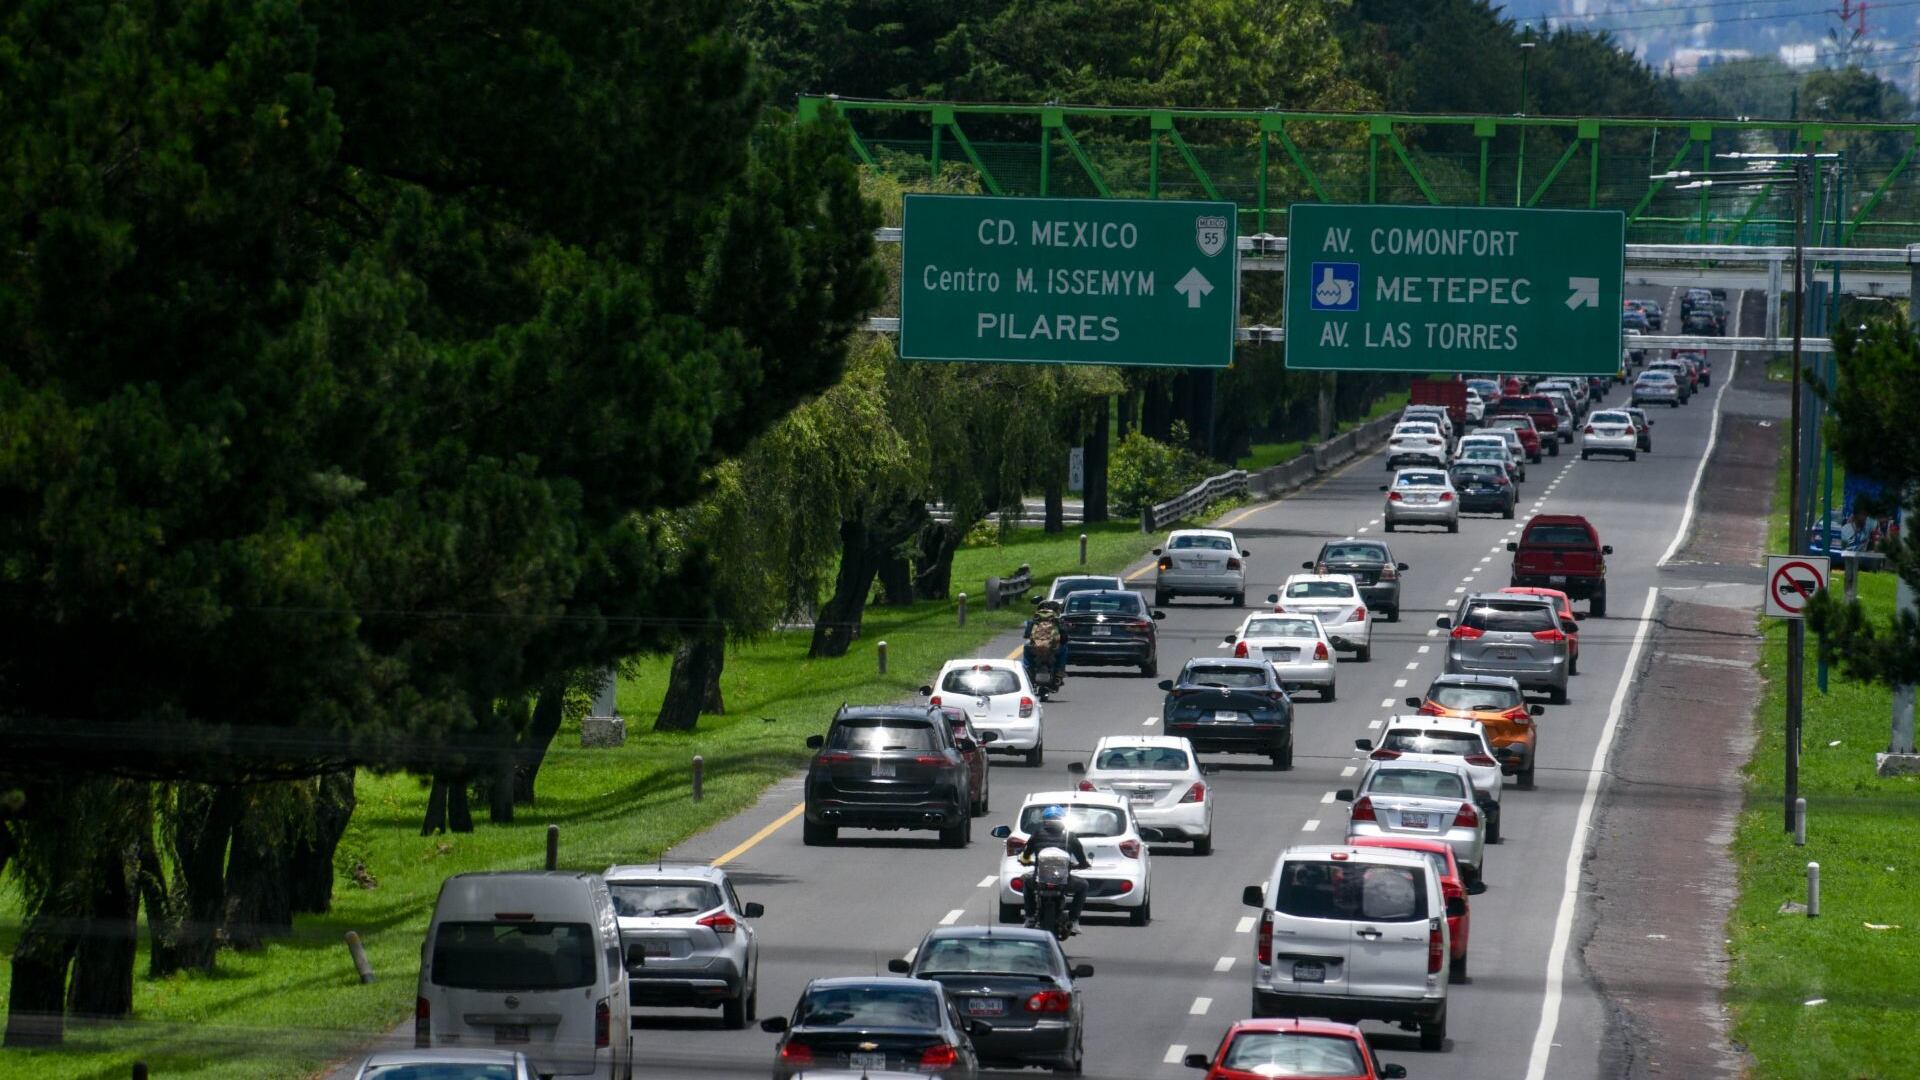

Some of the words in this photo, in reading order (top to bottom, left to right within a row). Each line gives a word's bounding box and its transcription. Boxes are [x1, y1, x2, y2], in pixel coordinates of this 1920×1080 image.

[978, 218, 1018, 246] CD.
[1032, 221, 1138, 249] MEXICO
[1199, 219, 1225, 227] MEXICO
[1204, 232, 1219, 245] 55
[1322, 227, 1354, 253] AV.
[1371, 228, 1519, 256] COMONFORT
[923, 265, 1000, 293] Centro
[1016, 268, 1038, 294] M.
[1048, 269, 1154, 297] ISSEMYM
[1376, 276, 1531, 304] METEPEC
[977, 312, 1120, 342] PILARES
[1319, 321, 1349, 348] AV.
[1365, 322, 1411, 348] LAS
[1425, 323, 1517, 350] TORRES
